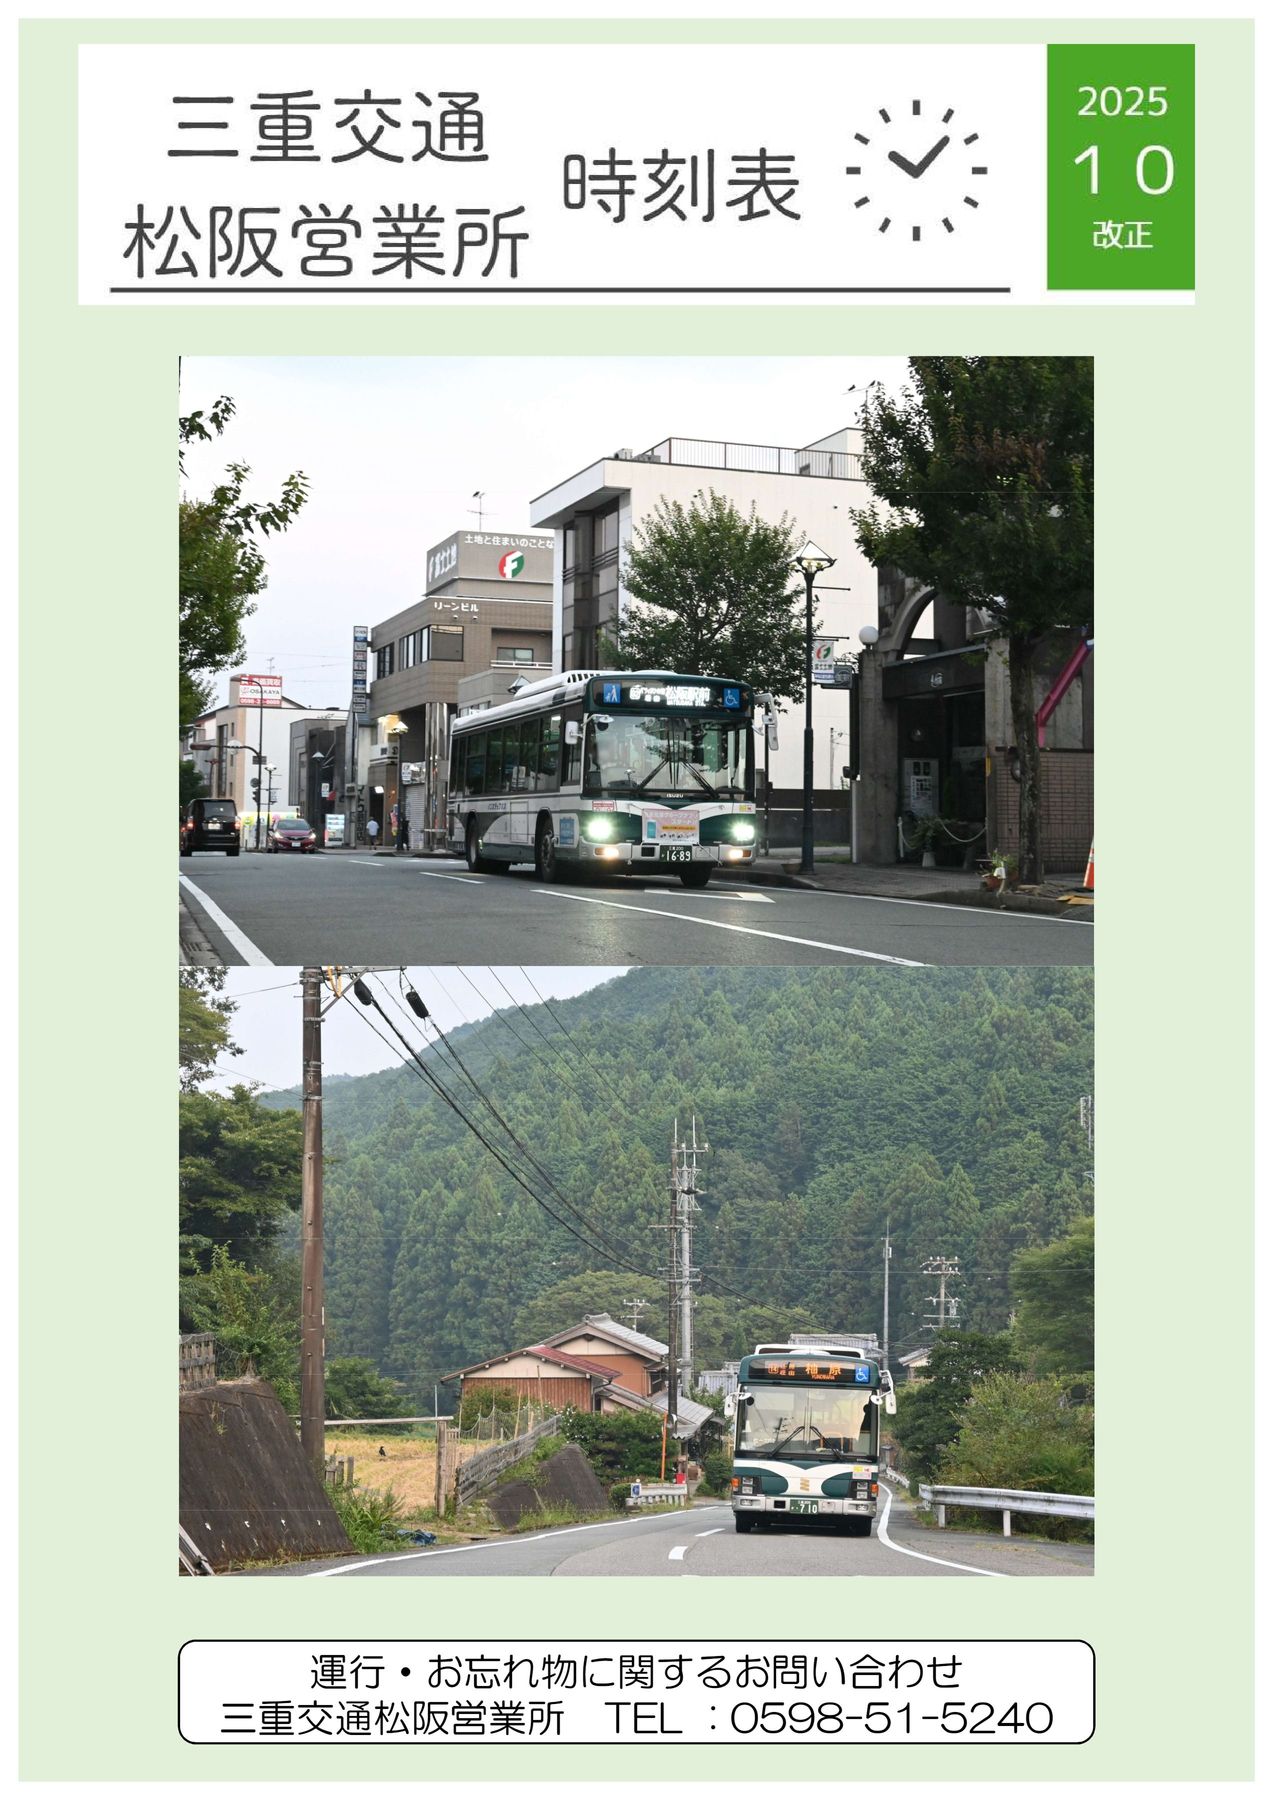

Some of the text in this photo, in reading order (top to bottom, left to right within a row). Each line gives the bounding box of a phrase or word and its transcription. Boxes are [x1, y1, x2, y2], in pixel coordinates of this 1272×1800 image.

[1078, 86, 1168, 116] 2025
[167, 88, 489, 164] 三重交通
[563, 146, 801, 224] 時刻表
[1074, 144, 1174, 195] 10
[122, 203, 530, 280] 松阪営業所
[1093, 219, 1154, 249] 改正
[310, 1653, 963, 1690] 運行・お忘れ物に関するお問い合わせ
[220, 1699, 565, 1736] 三重交通松阪営業所
[604, 1701, 683, 1734] TEL
